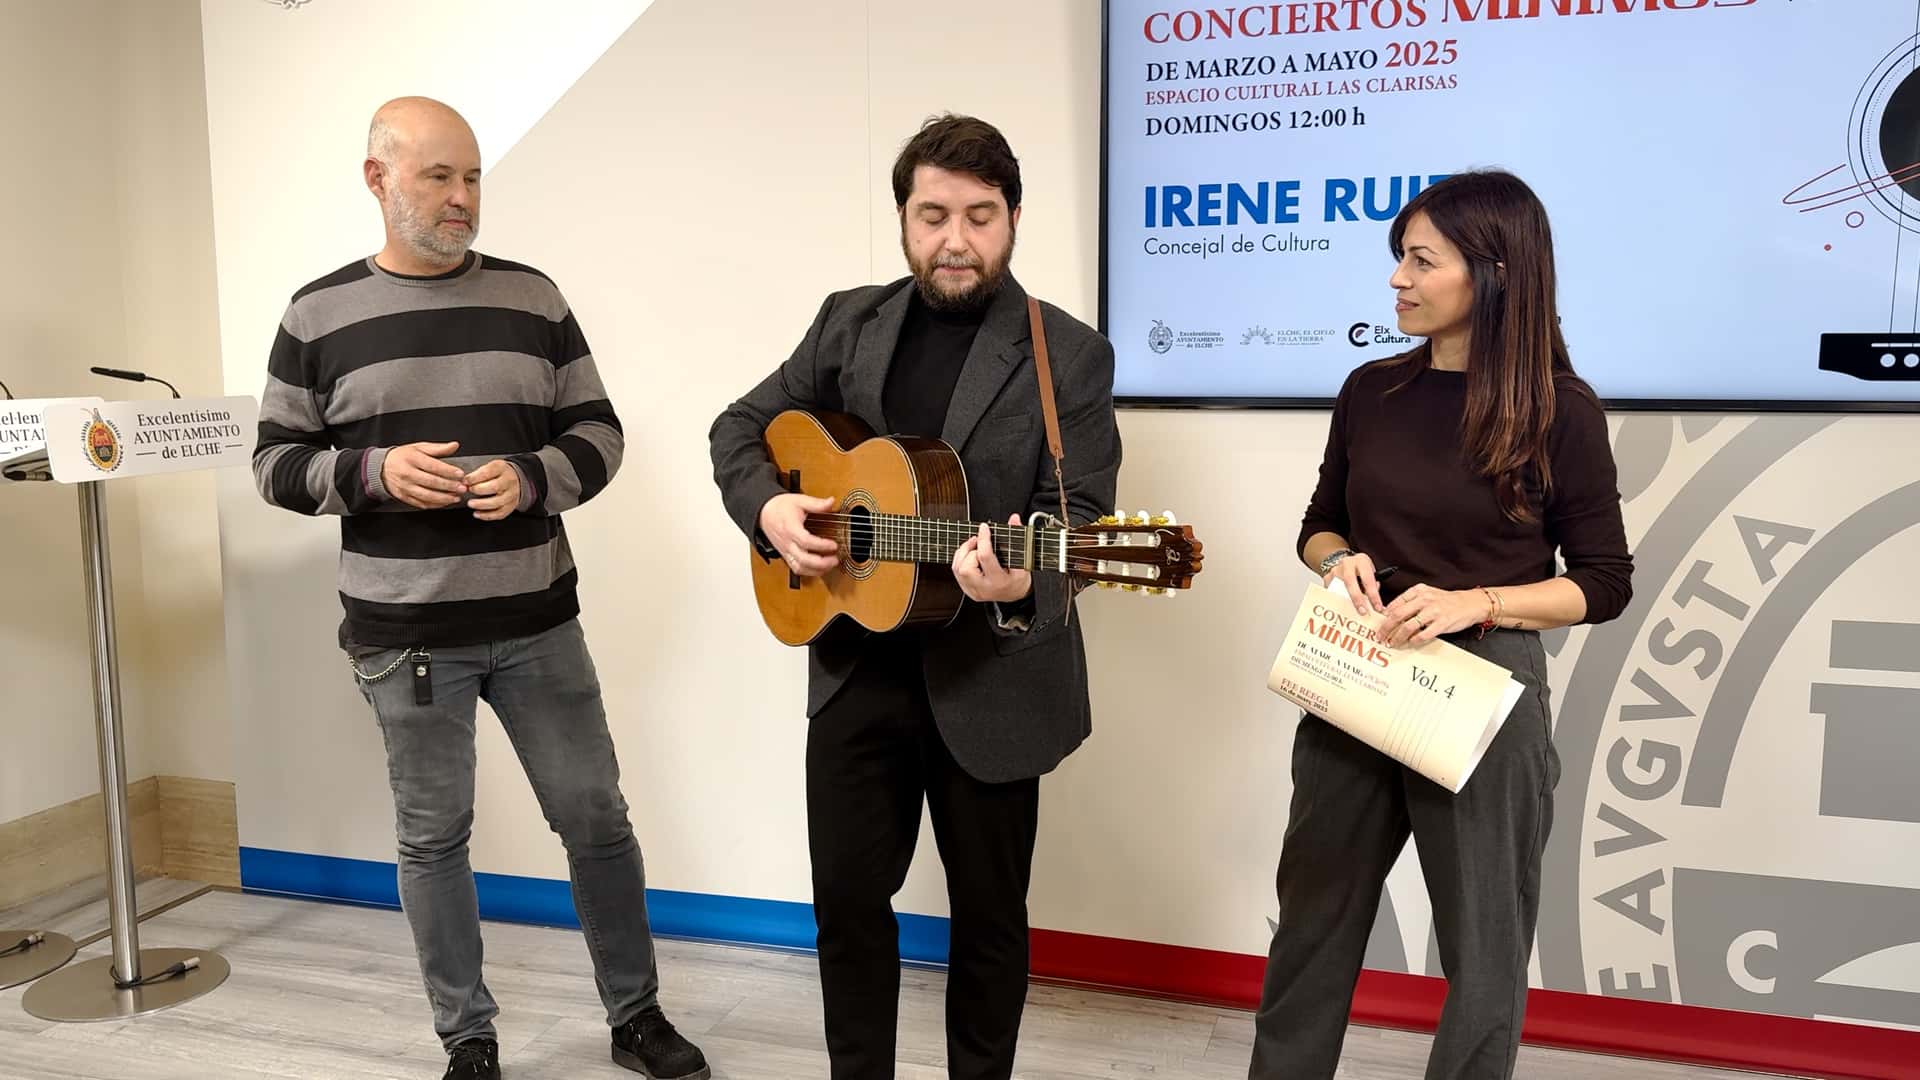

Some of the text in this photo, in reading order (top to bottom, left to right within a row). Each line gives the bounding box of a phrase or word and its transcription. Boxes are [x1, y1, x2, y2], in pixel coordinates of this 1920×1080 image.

[1143, 0, 1427, 43] CONCIERTOS
[1145, 40, 1458, 82] DE MARZO A MAYO 2025
[1144, 73, 1458, 106] ESPACIO CULTURAL LAS CLARISAS
[1145, 106, 1366, 136] DOMINGOS 12:00 h
[1144, 174, 1456, 228] IRENE RUI
[1144, 232, 1331, 259] Concejal de Cultura
[1374, 325, 1391, 335] Elx
[1374, 334, 1412, 344] Cultura
[133, 424, 241, 445] AYUNTAMIENTO
[162, 442, 223, 459] de ELCHE
[1304, 617, 1392, 669] MÍNIMS
[1411, 665, 1438, 693] Vol.
[1443, 685, 1456, 699] 4
